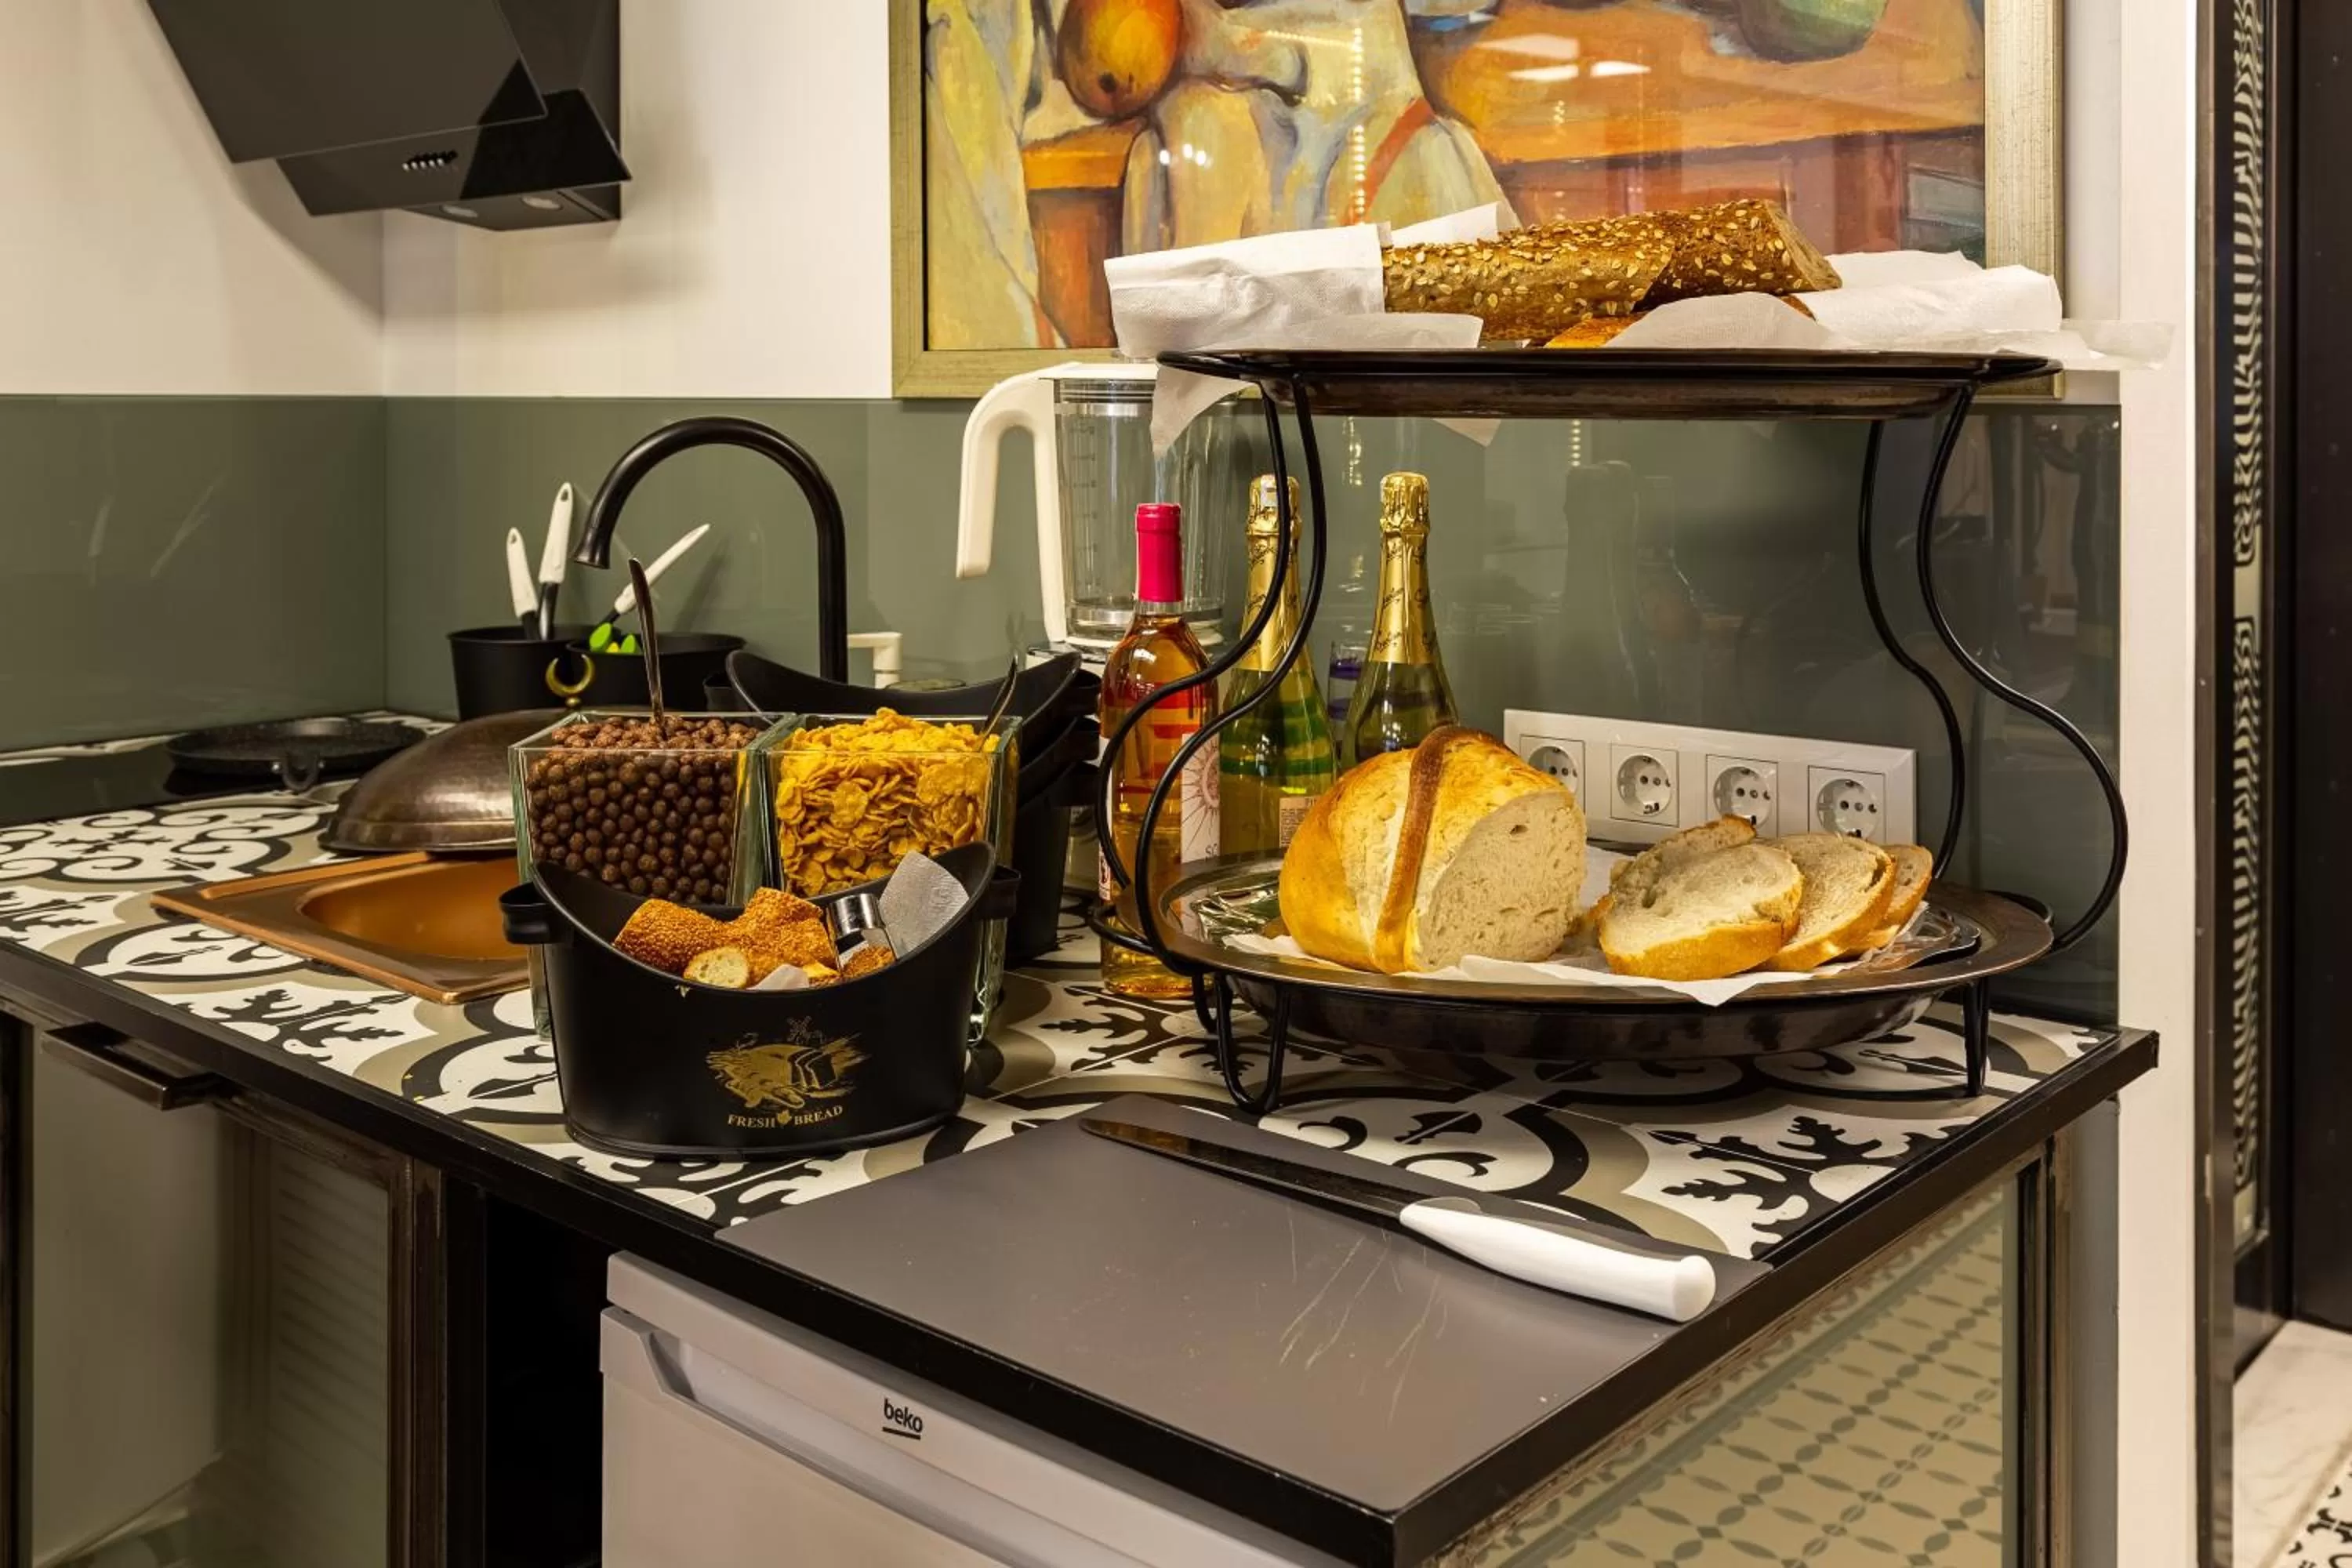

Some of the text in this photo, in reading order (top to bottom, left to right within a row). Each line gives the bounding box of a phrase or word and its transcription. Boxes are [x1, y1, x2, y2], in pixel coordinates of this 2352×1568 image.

[727, 1105, 843, 1128] FRESH BREAD
[884, 1398, 923, 1433] beko
